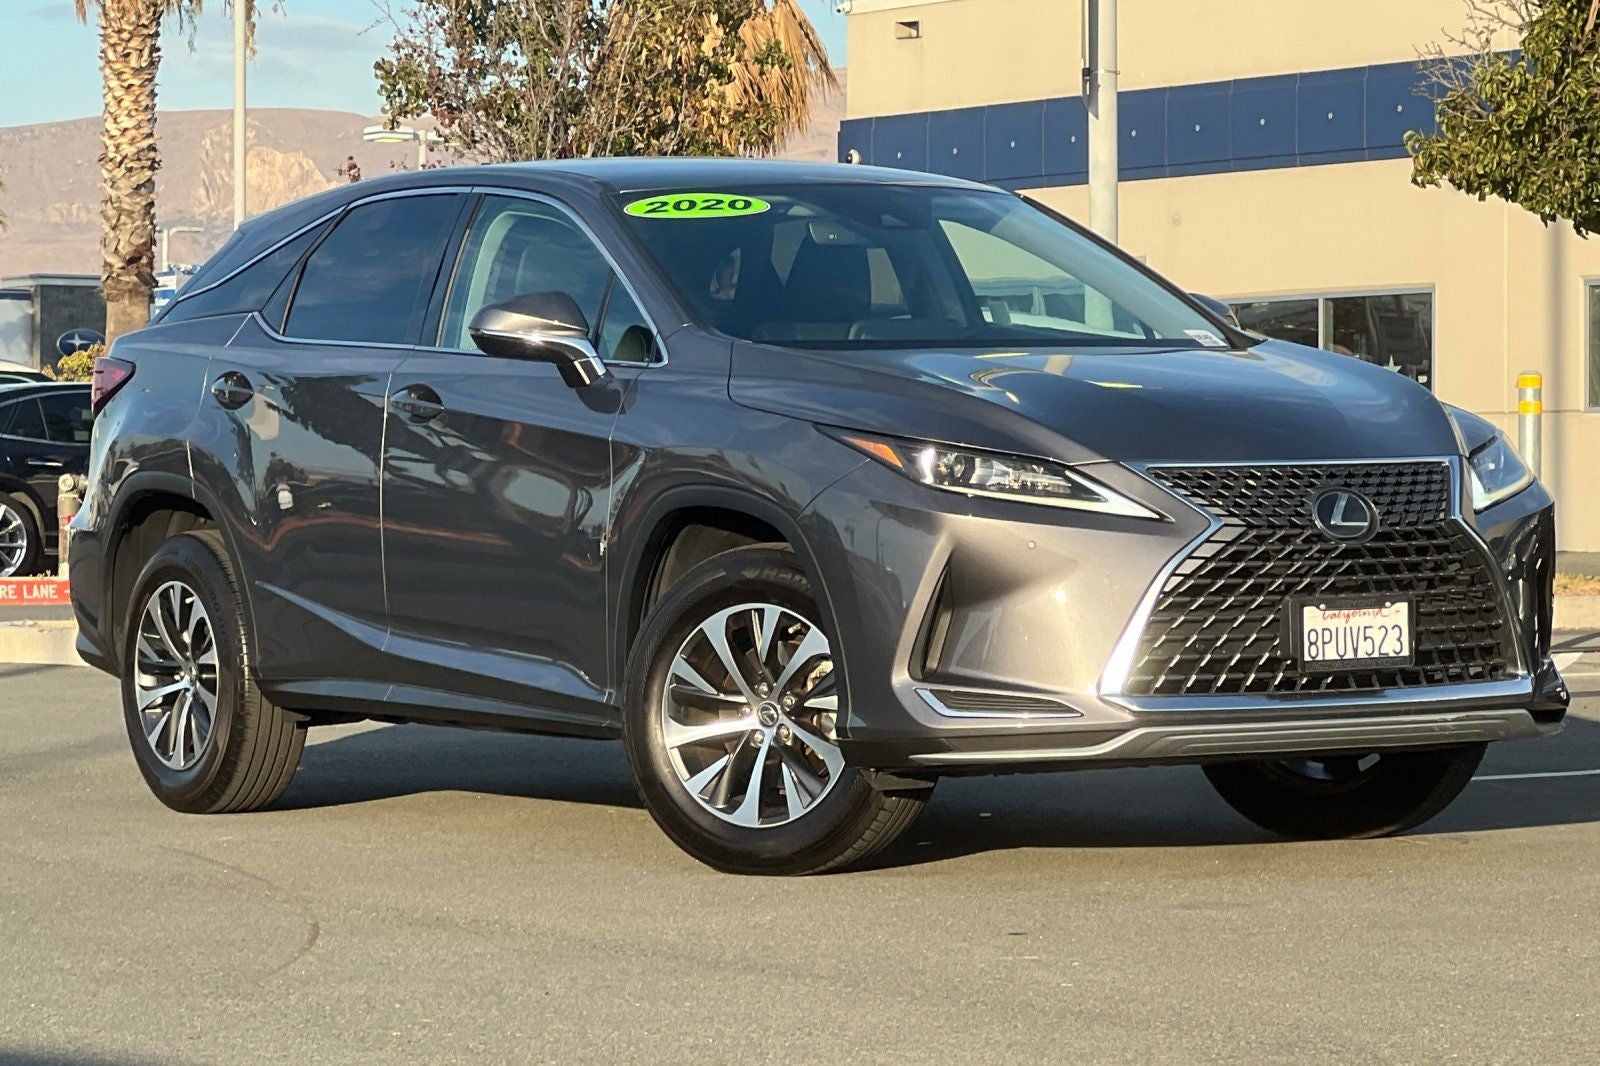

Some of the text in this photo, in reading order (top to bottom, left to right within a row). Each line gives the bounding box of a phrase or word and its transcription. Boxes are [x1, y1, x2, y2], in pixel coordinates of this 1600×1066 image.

[643, 198, 752, 214] 2020
[22, 584, 58, 599] LANE
[1307, 624, 1404, 660] 8PUV523
